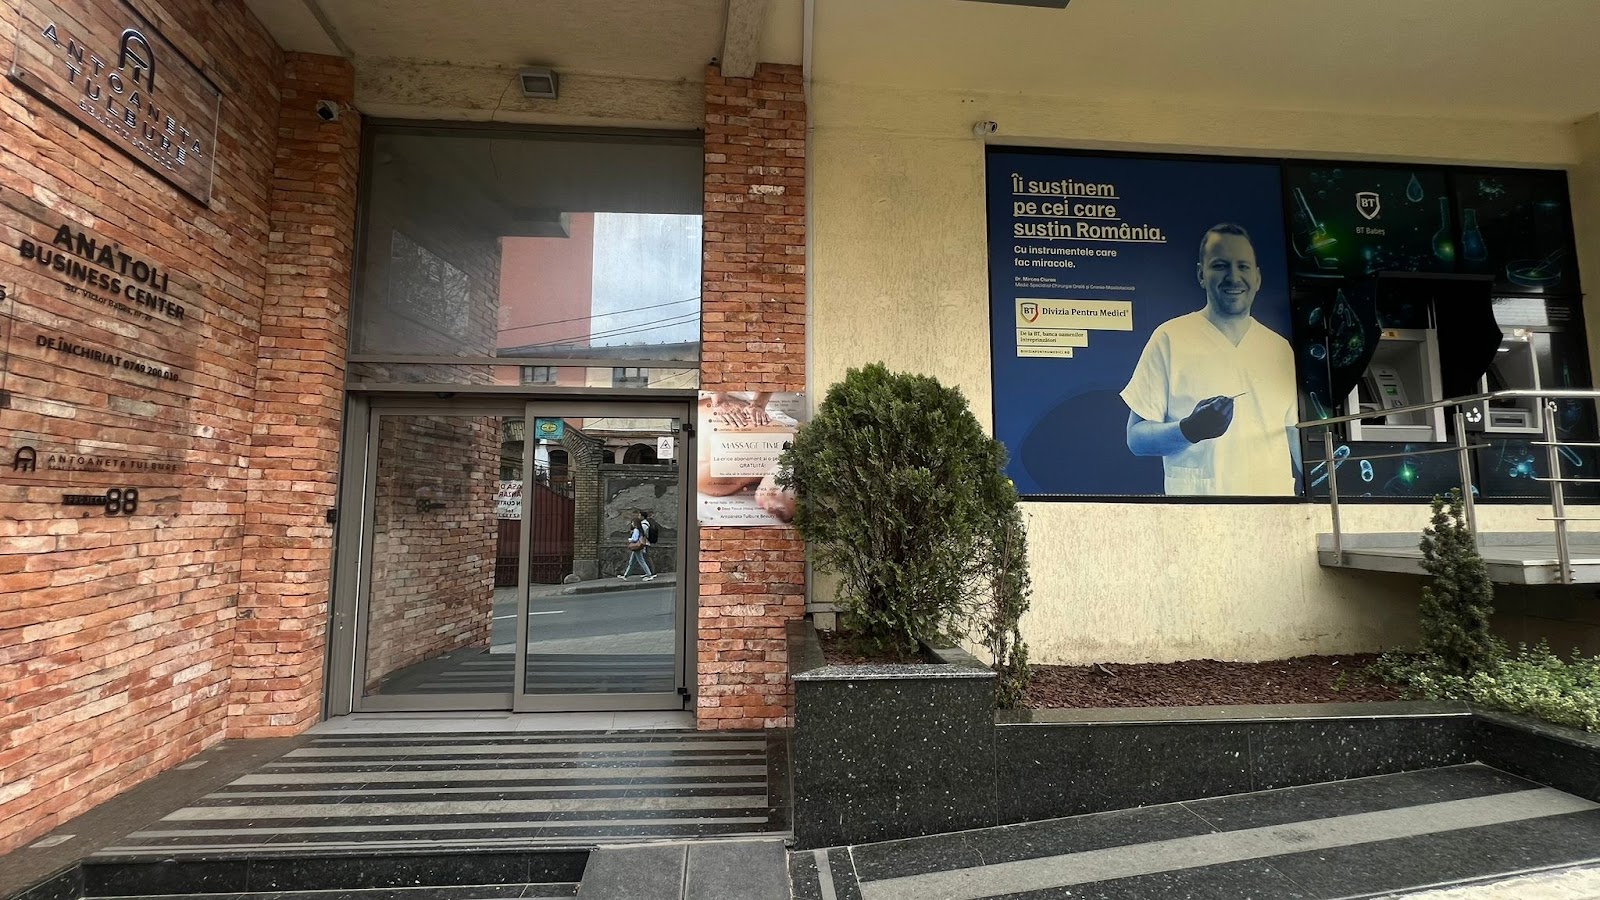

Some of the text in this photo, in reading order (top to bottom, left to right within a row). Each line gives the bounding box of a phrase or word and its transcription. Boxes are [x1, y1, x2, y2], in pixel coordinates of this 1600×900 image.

[42, 23, 202, 157] ANTOANETA
[65, 61, 186, 165] TULBURE
[1011, 173, 1115, 198] Îi susținem
[1013, 200, 1116, 218] pe cei care
[1361, 198, 1375, 207] BT
[1013, 221, 1167, 241] susțin România.
[1355, 226, 1365, 234] BT
[53, 224, 169, 292] ANATOLI
[1014, 245, 1117, 257] Cu instrumentele care
[1014, 258, 1076, 268] fac miracole.
[19, 239, 186, 321] BUSINESS CENTER
[1042, 307, 1069, 316] Divizia
[1071, 308, 1098, 317] Pentru
[36, 335, 54, 349] DE
[58, 337, 122, 367] ÎNCHIRIAT
[49, 454, 126, 469] ANTOANETA
[130, 460, 179, 472] TULBURE
[105, 486, 138, 516] 88
